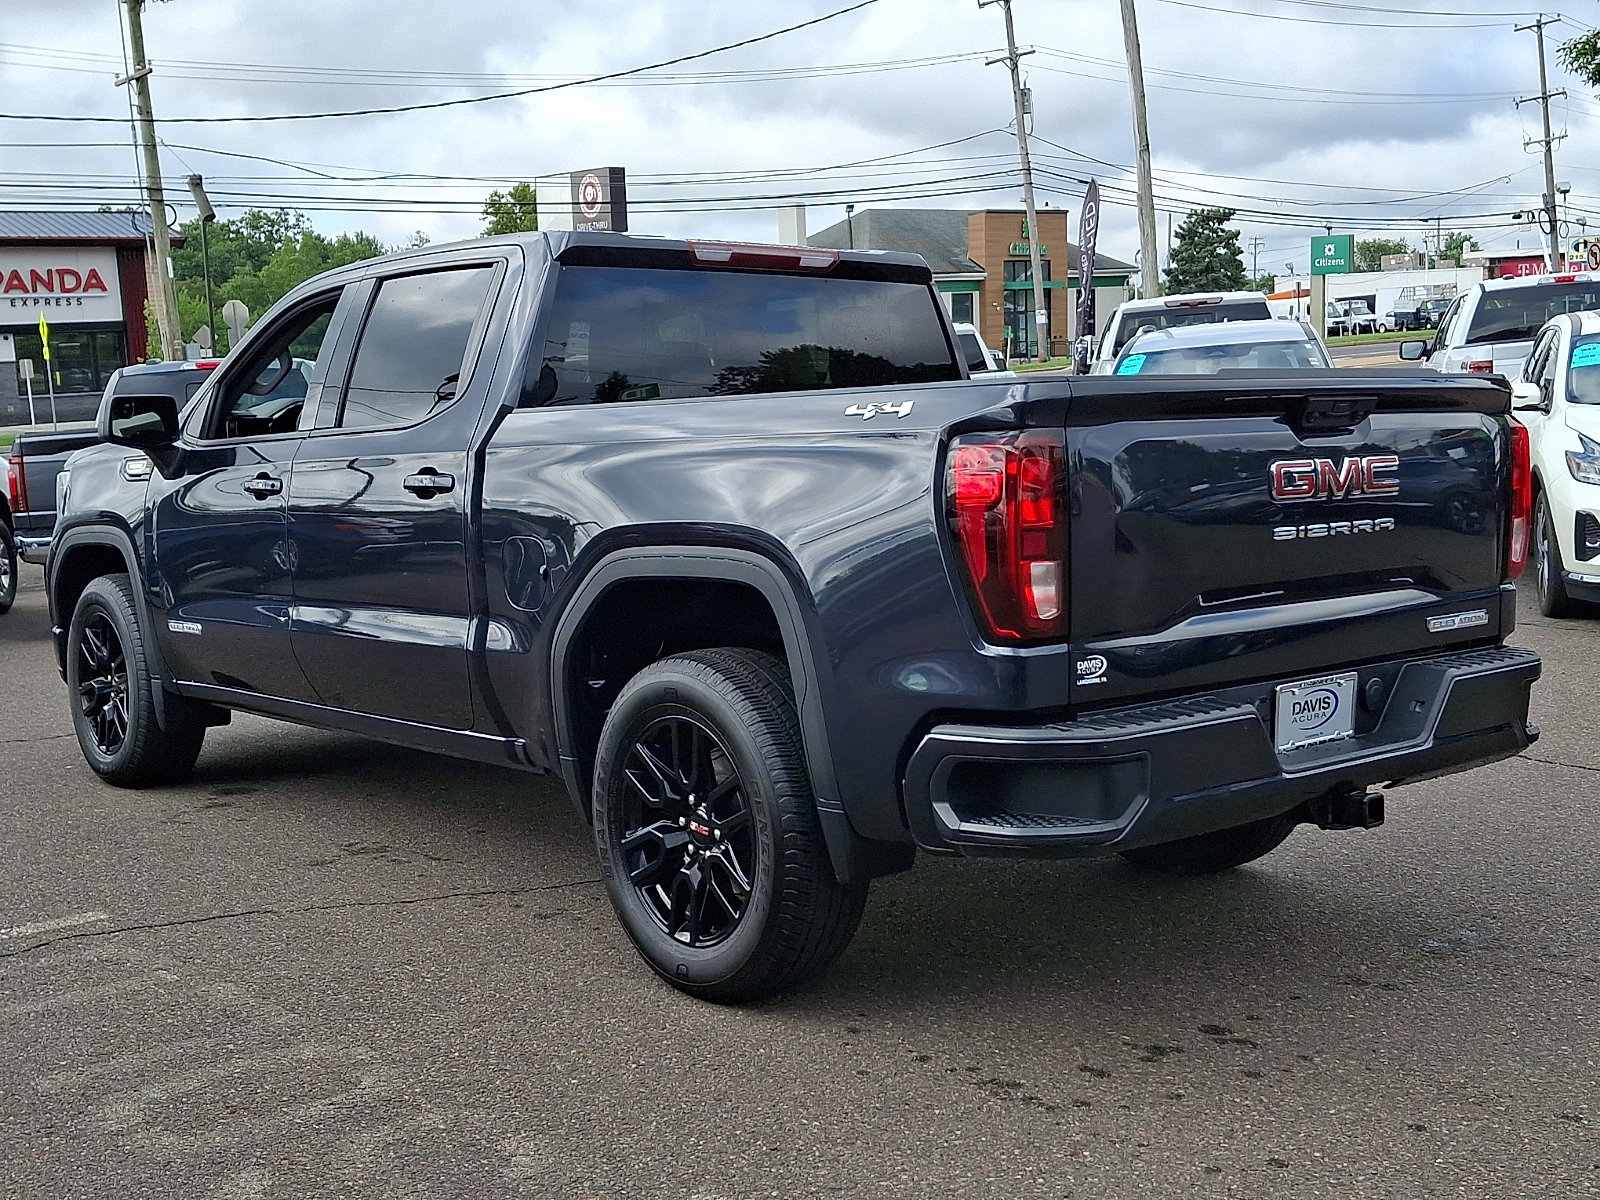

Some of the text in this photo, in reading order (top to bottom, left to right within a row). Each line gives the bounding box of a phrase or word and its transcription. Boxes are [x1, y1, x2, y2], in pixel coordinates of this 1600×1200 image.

[576, 221, 609, 231] DRIVE-THRU
[1314, 258, 1345, 267] Citizens
[9, 297, 83, 308] EXPRESS
[1269, 455, 1400, 501] GMC
[1272, 517, 1396, 541] SIERRA
[1076, 659, 1102, 670] DAVIS
[1076, 667, 1100, 675] ACURA
[1291, 695, 1331, 716] DAVIS
[1291, 711, 1327, 724] ACURA
